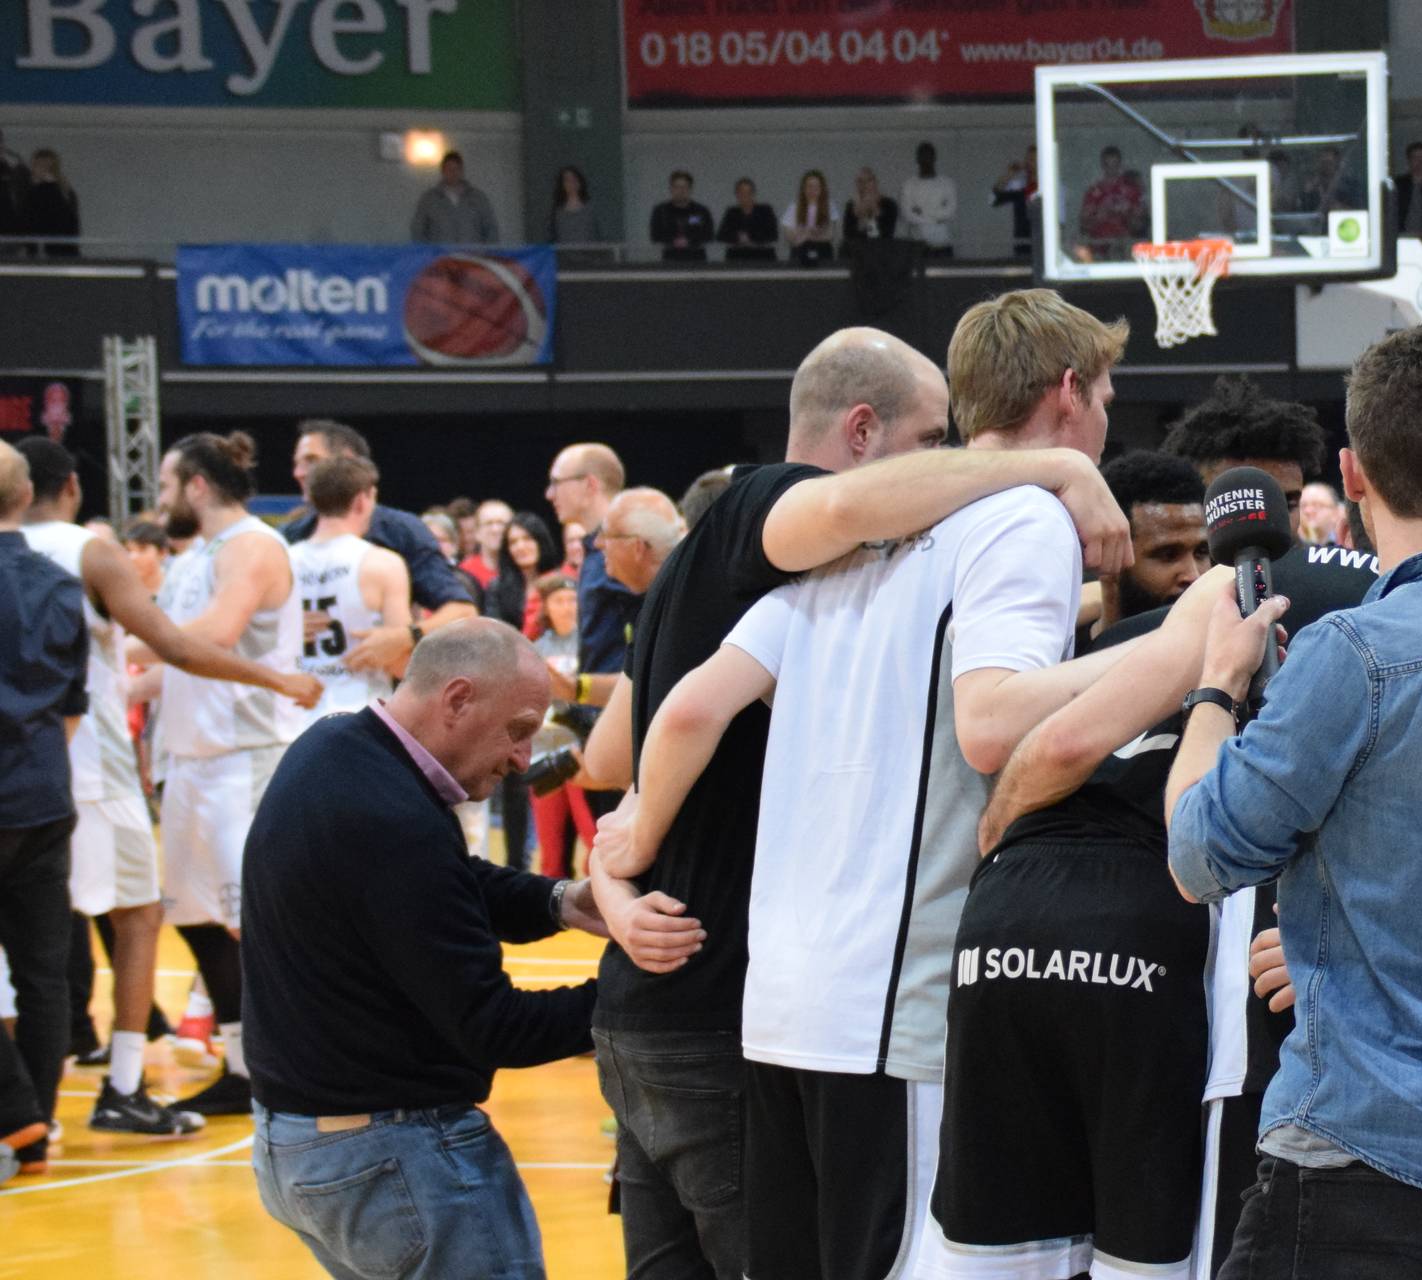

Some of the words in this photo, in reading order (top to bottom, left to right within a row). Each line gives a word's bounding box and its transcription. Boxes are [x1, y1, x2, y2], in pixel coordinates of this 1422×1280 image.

[15, 0, 458, 95] Bayer
[718, 30, 832, 66] 05/04
[838, 29, 887, 64] 04
[960, 37, 1164, 63] www.bayer04.de
[195, 268, 389, 315] molten
[1205, 488, 1264, 516] ANTENNE
[1206, 500, 1265, 527] MÜNSTER
